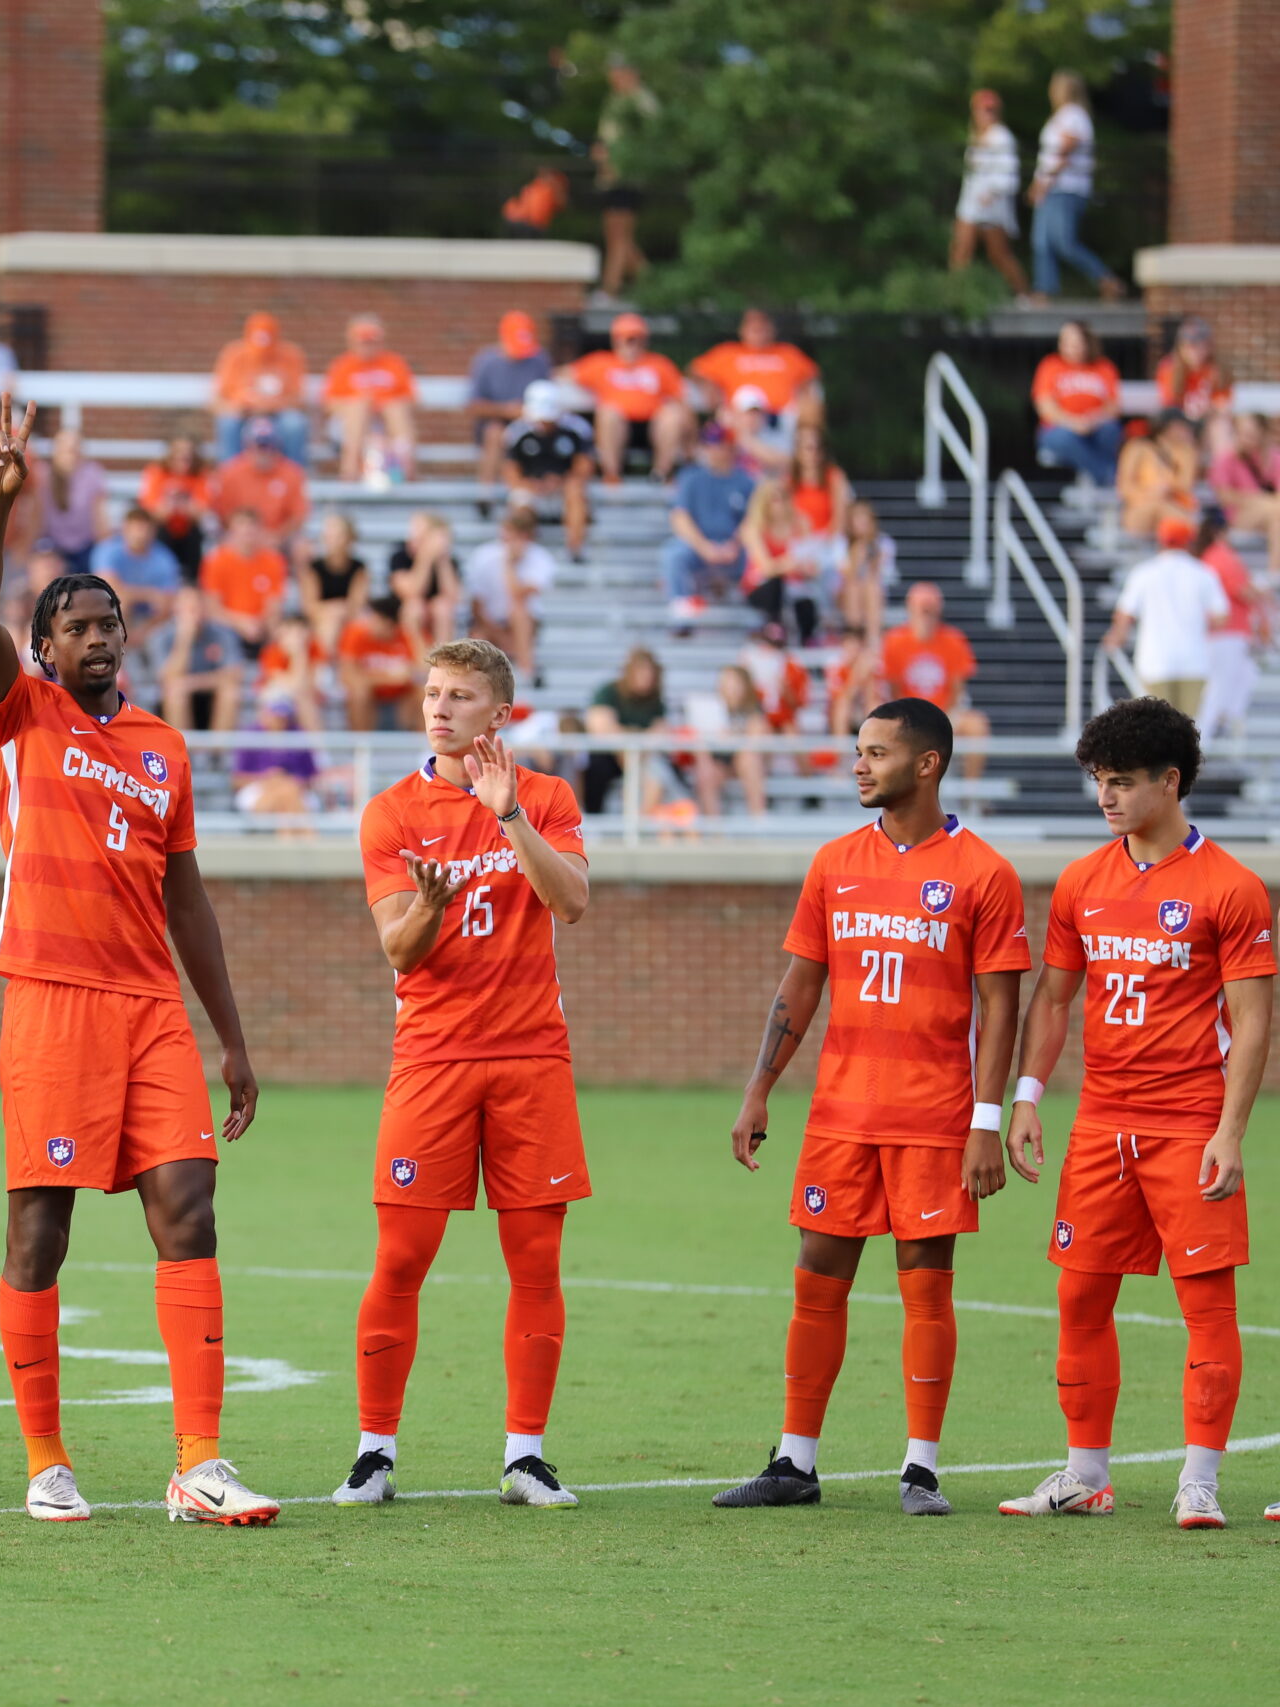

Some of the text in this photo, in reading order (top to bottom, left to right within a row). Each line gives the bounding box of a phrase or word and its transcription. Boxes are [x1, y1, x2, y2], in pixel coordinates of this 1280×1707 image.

[63, 746, 170, 820] CLEMSON
[106, 801, 129, 852] 5
[422, 847, 525, 885] EMSO
[461, 885, 494, 937] 15
[832, 911, 949, 952] CLEMSON
[859, 949, 904, 1004] 20
[1104, 972, 1146, 1026] 25
